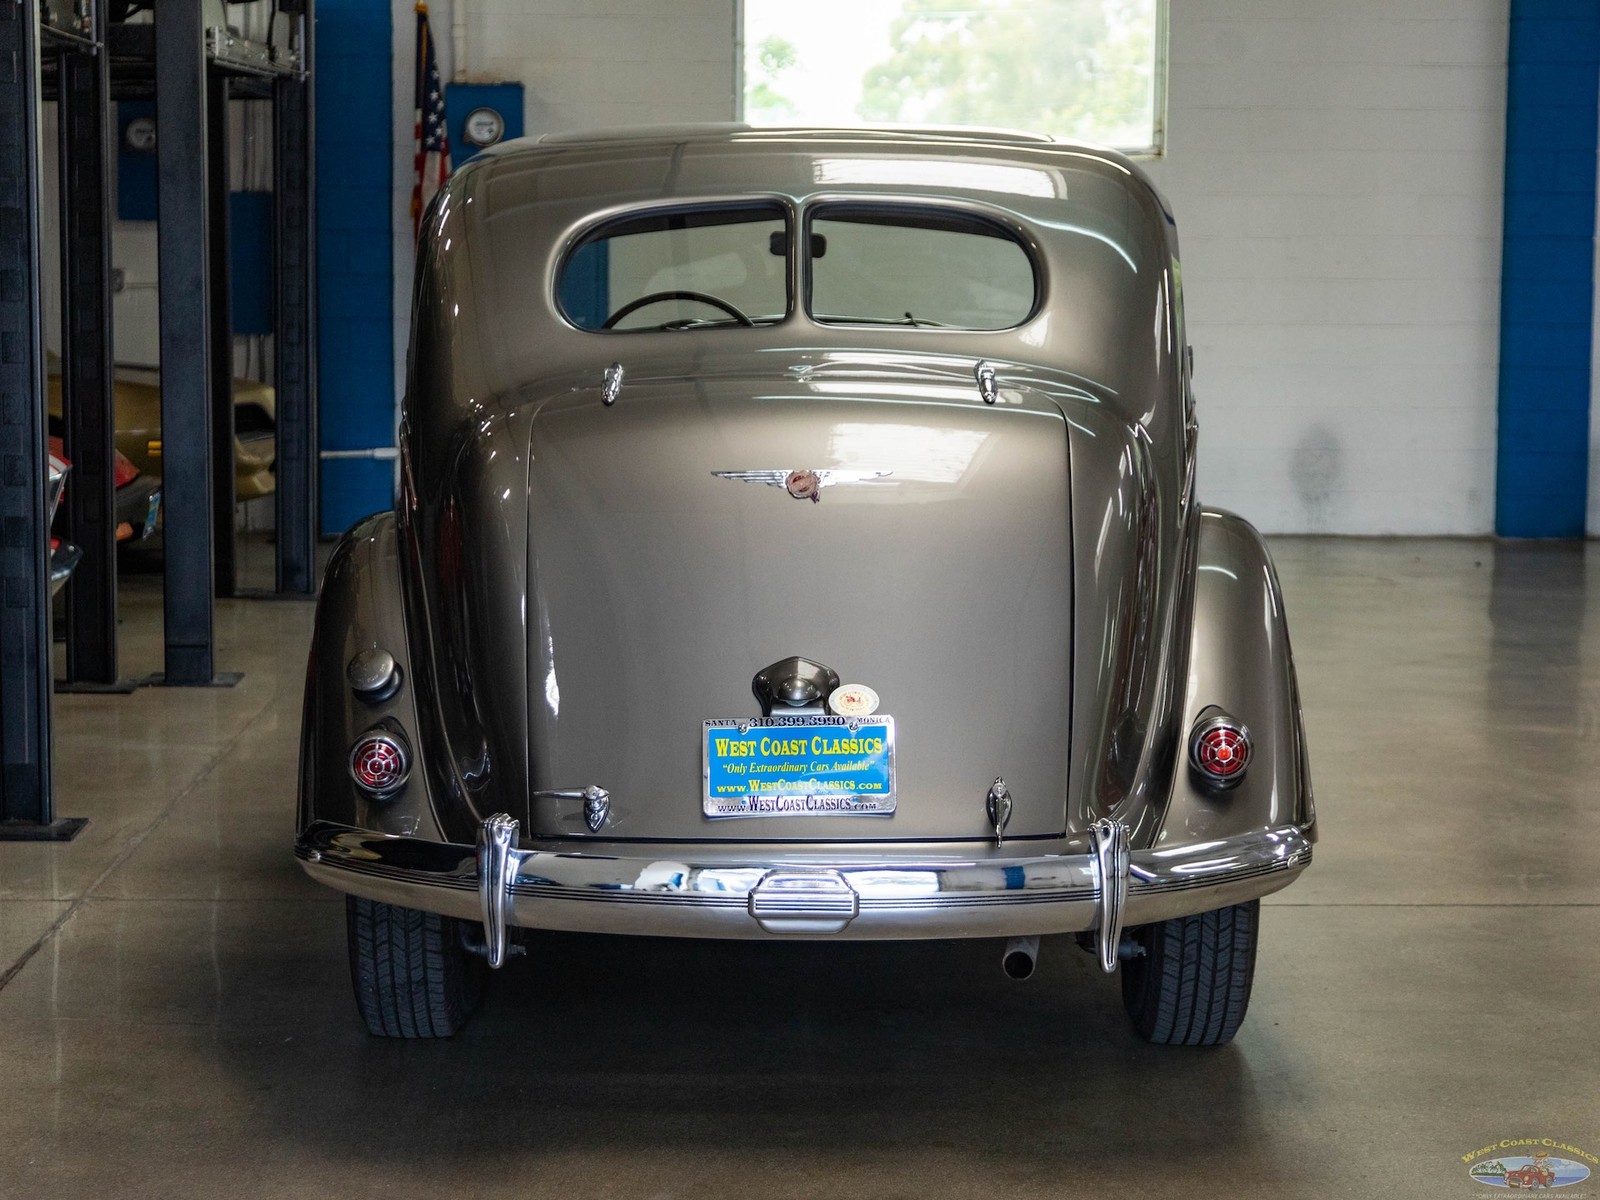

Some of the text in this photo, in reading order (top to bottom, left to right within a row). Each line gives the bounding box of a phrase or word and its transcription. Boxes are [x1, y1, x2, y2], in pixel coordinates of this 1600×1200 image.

[704, 719, 737, 727] SANTA
[749, 717, 846, 727] 310.399.3990
[715, 736, 883, 757] WEST COAST CLASSICS
[749, 762, 809, 774] Extraordinary
[810, 761, 829, 771] Cars
